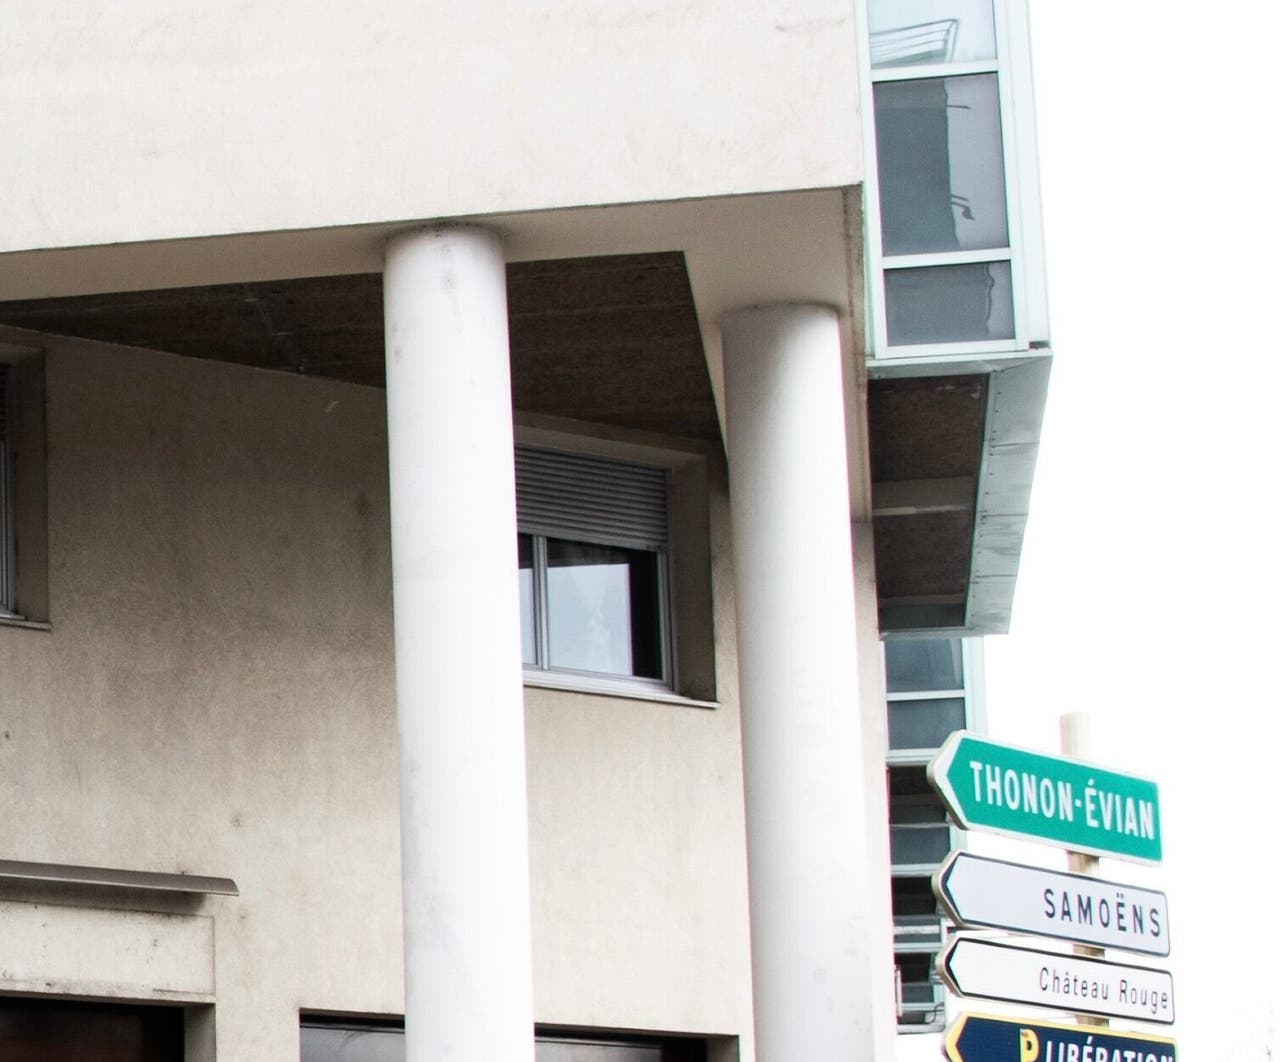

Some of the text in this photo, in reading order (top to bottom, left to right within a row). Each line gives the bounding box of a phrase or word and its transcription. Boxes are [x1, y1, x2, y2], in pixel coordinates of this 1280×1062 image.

[970, 761, 1156, 840] THONON-ÉVIAN
[1043, 889, 1161, 938] SAMOËNS
[1039, 967, 1168, 1014] Château Rouge
